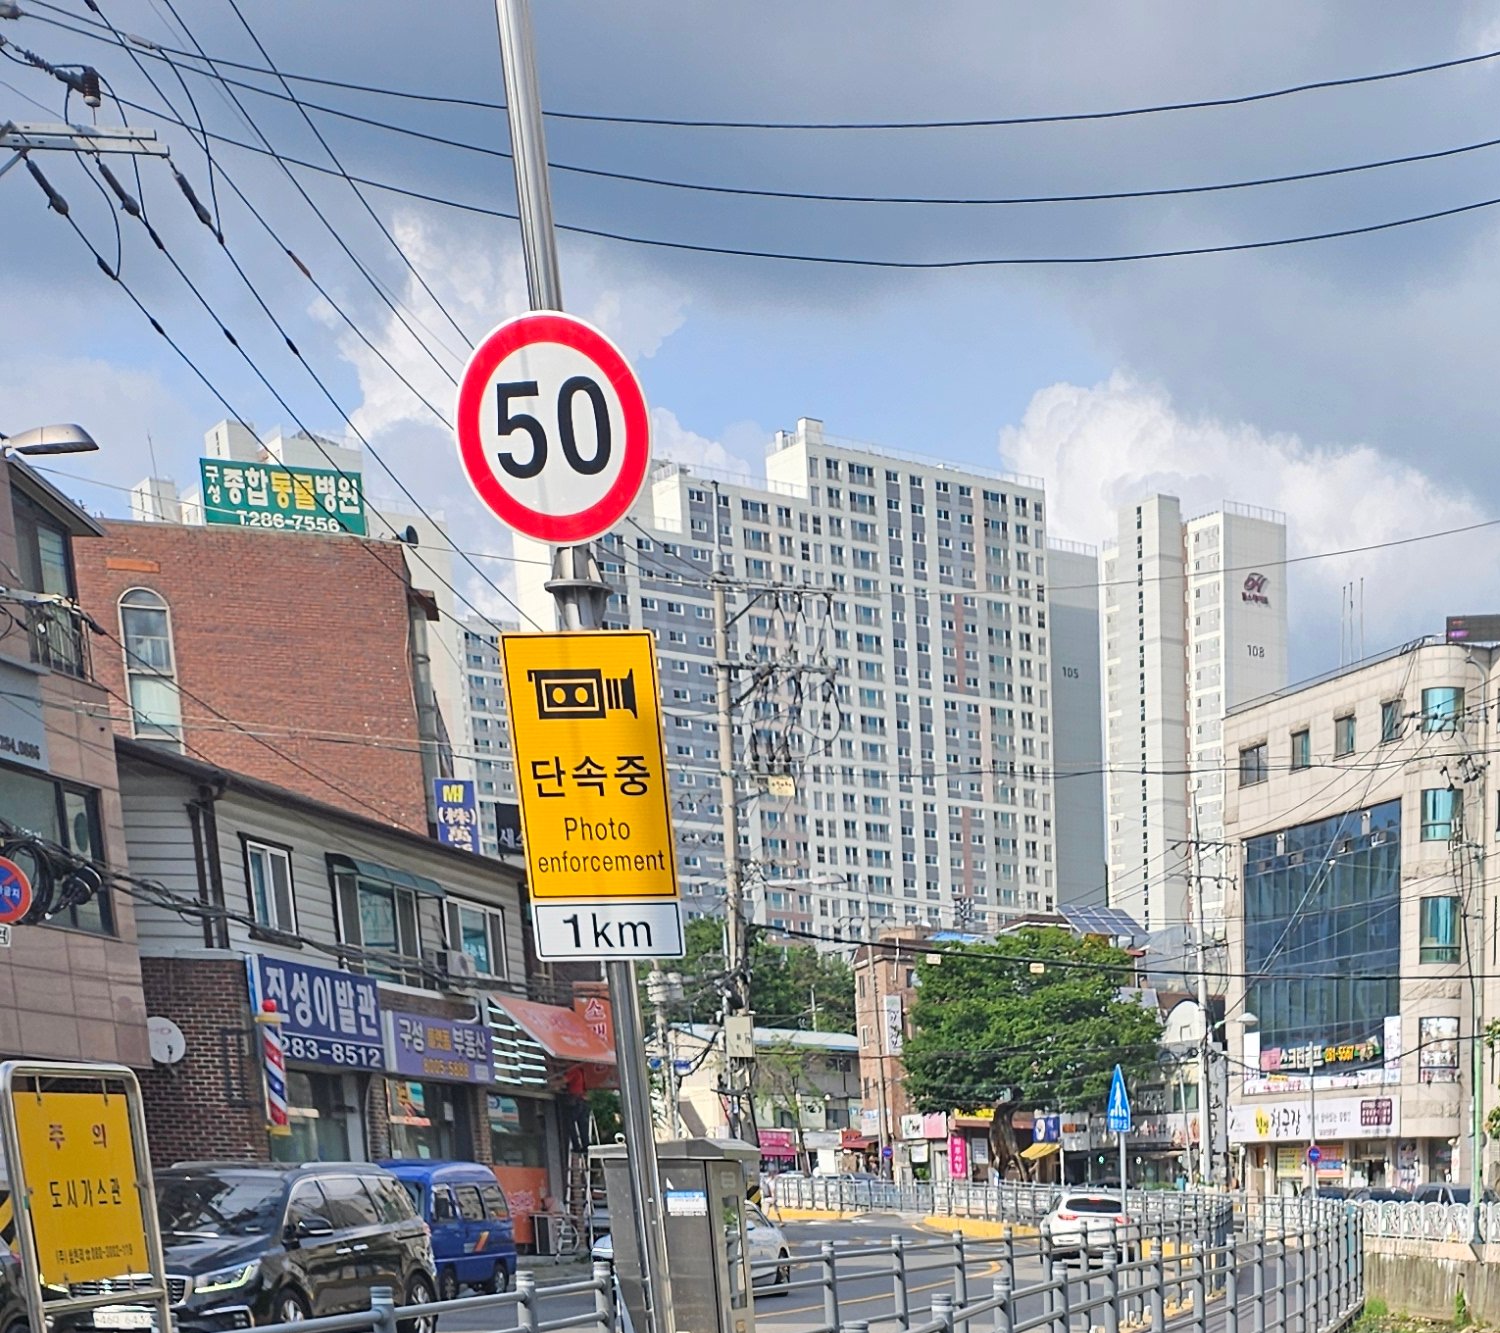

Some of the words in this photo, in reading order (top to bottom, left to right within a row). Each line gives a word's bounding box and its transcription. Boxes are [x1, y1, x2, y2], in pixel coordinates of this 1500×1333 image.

[496, 375, 612, 480] 50
[1062, 666, 1079, 679] 105
[531, 755, 651, 798] 단속중
[564, 816, 631, 841] Photo
[538, 850, 666, 873] enforcement
[562, 912, 653, 949] 1km
[399, 1018, 424, 1052] 구성
[452, 1026, 487, 1060] 부동산
[49, 1178, 122, 1208] 도시가스관
